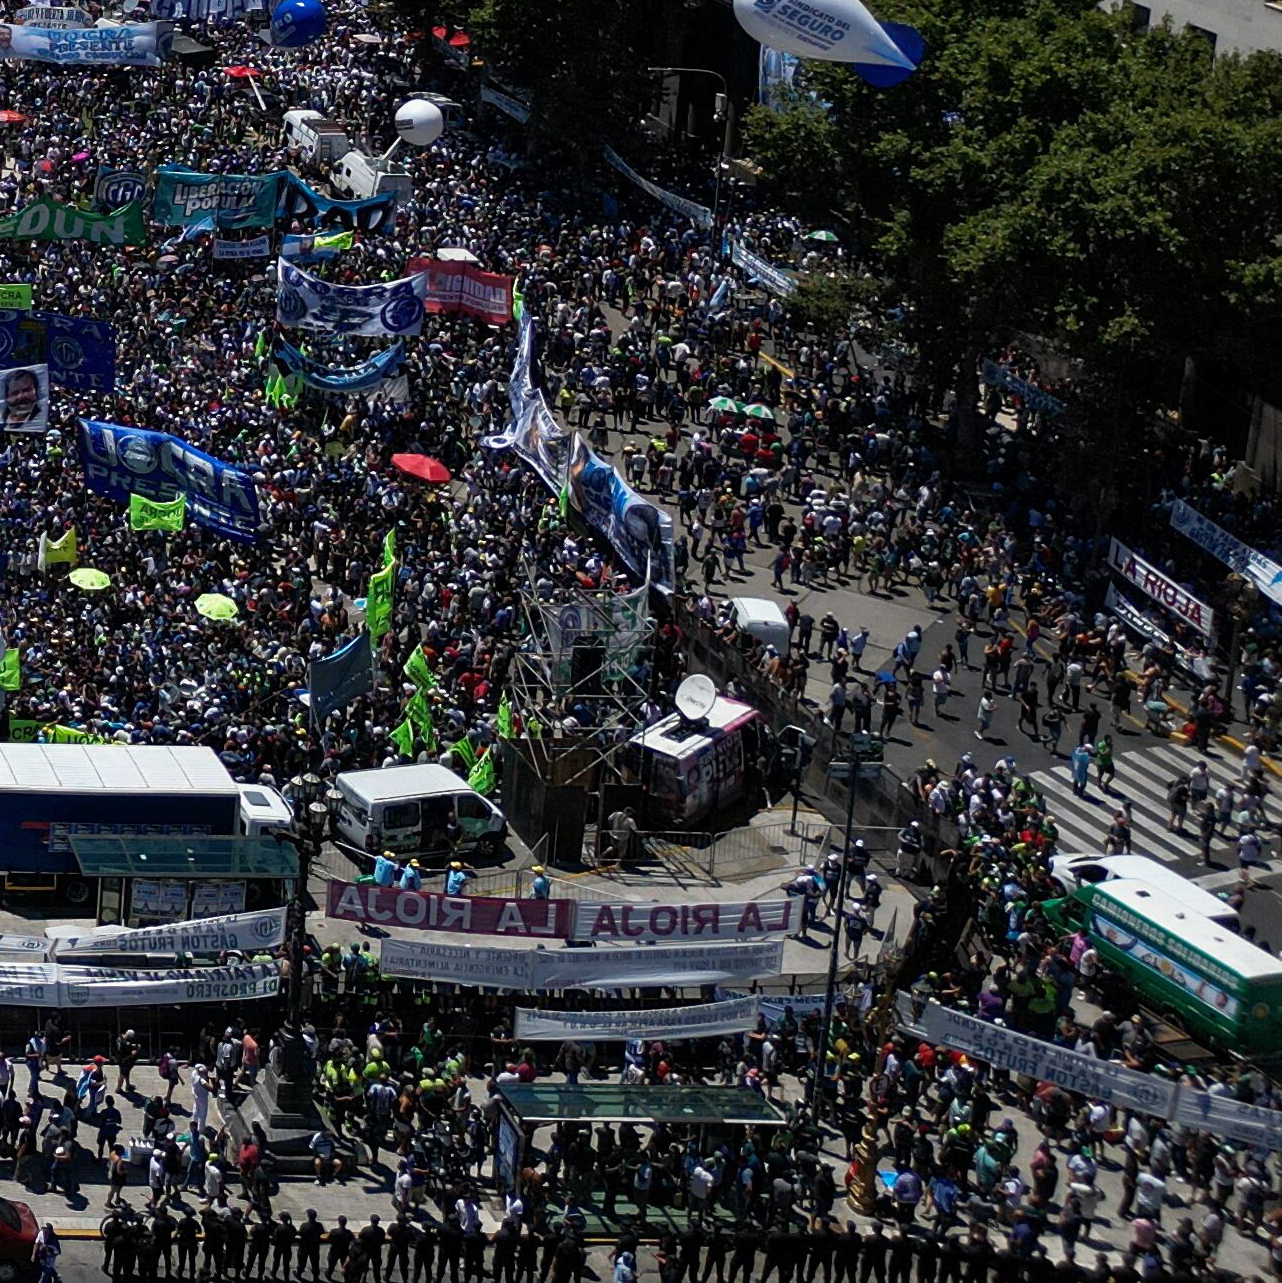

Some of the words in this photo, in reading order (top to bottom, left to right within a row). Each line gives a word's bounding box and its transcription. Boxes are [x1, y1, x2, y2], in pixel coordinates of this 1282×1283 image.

[47, 28, 133, 41] UOCRA
[778, 4, 845, 41] SEGURO
[836, 20, 851, 30] DEL
[185, 196, 256, 216] POPULAR
[1114, 544, 1137, 579] LA
[1143, 572, 1203, 627] RIOJA
[1092, 893, 1166, 945] CAMIONEROS
